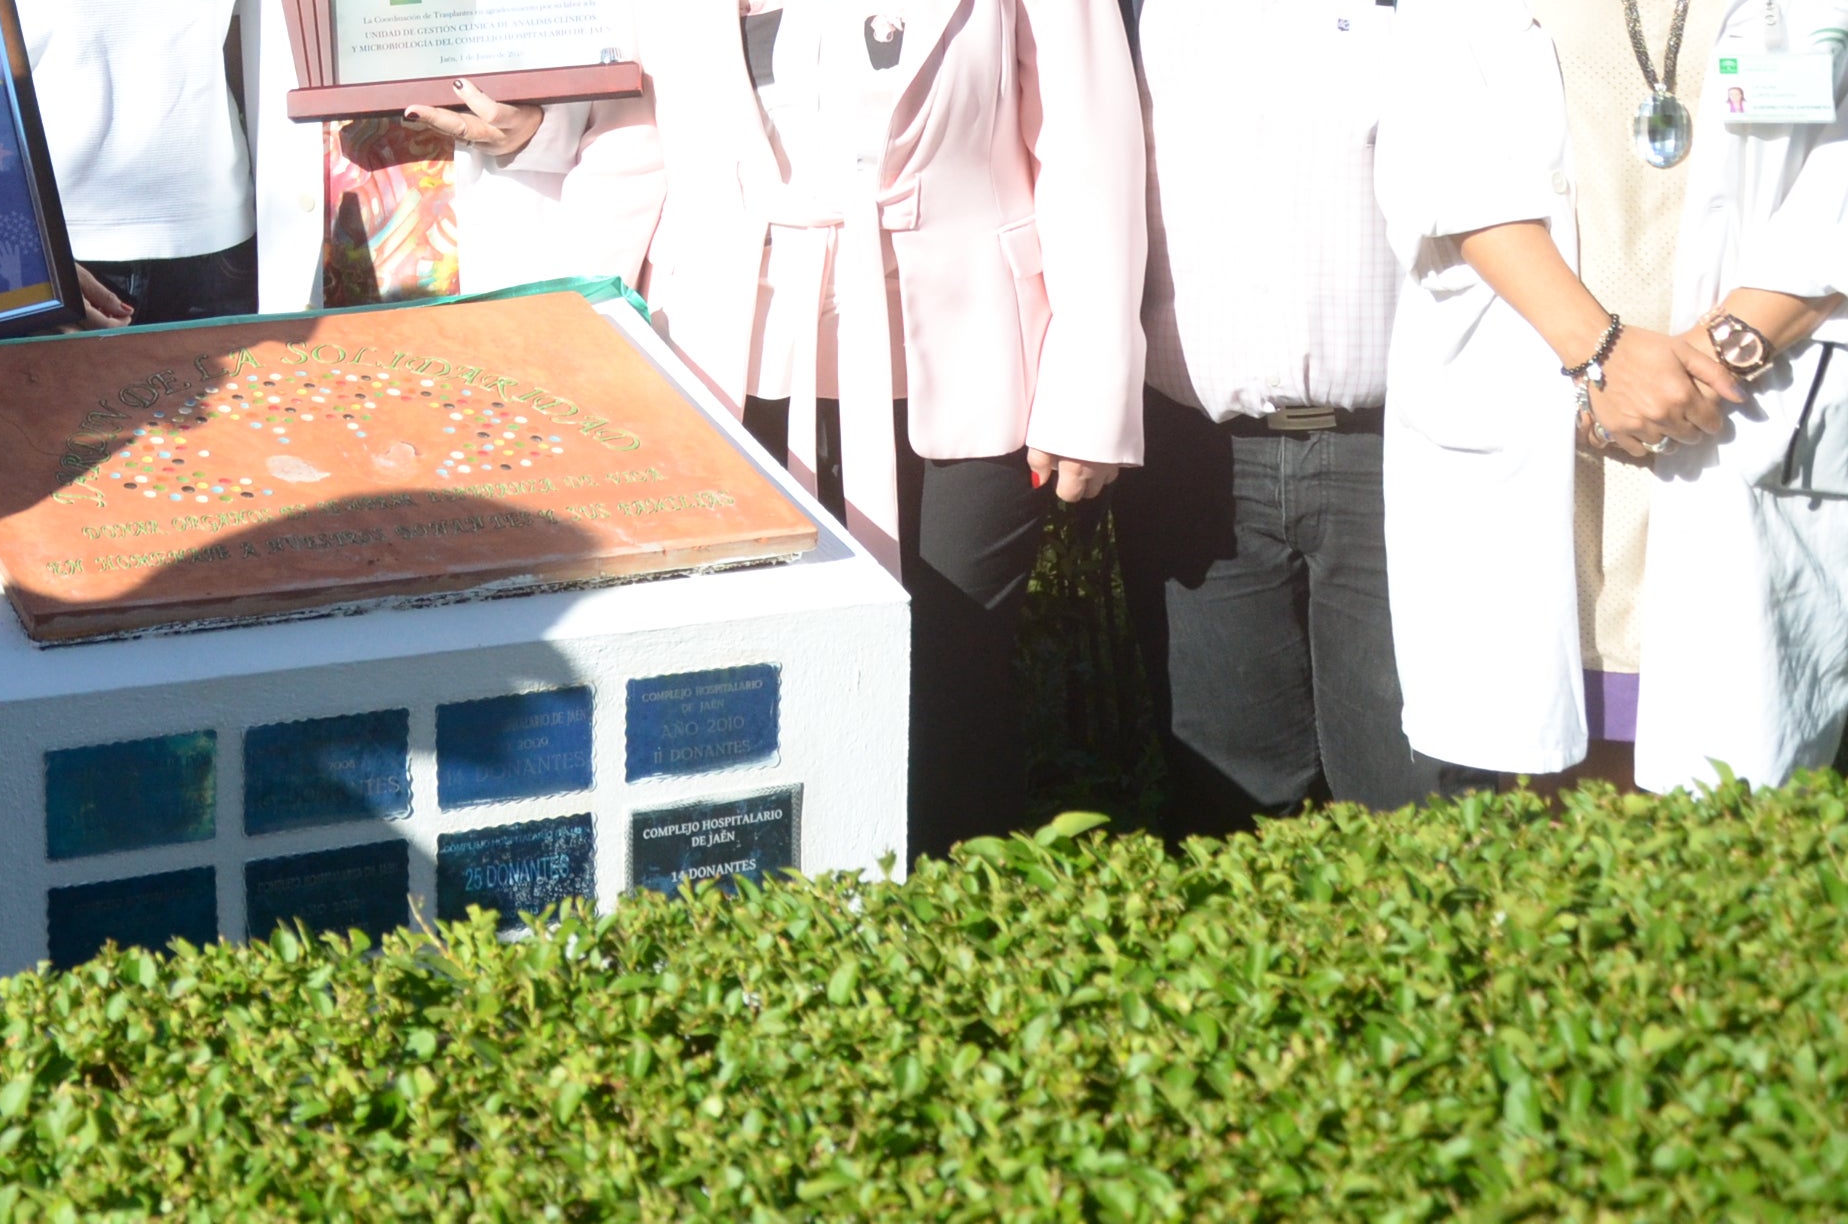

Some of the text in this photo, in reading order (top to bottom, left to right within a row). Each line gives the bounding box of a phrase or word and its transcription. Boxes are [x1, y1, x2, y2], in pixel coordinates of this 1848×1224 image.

[351, 45, 358, 53] Y
[435, 37, 452, 47] DEL
[365, 29, 402, 39] UNIDAD
[403, 28, 414, 37] DE
[193, 346, 264, 380] LA
[281, 340, 641, 452] SOLIDARIDAD
[641, 679, 764, 703] COMPLEJO HOSPITALARIO
[680, 703, 693, 714] DE
[661, 716, 746, 740] AÑO 2010
[670, 739, 752, 762] DONANTES
[642, 808, 784, 840] COMPLEJO HOSPITALARIO
[691, 835, 706, 848] DE
[464, 854, 570, 892] 25 DONANTES
[671, 858, 757, 882] 14 DONANTES
